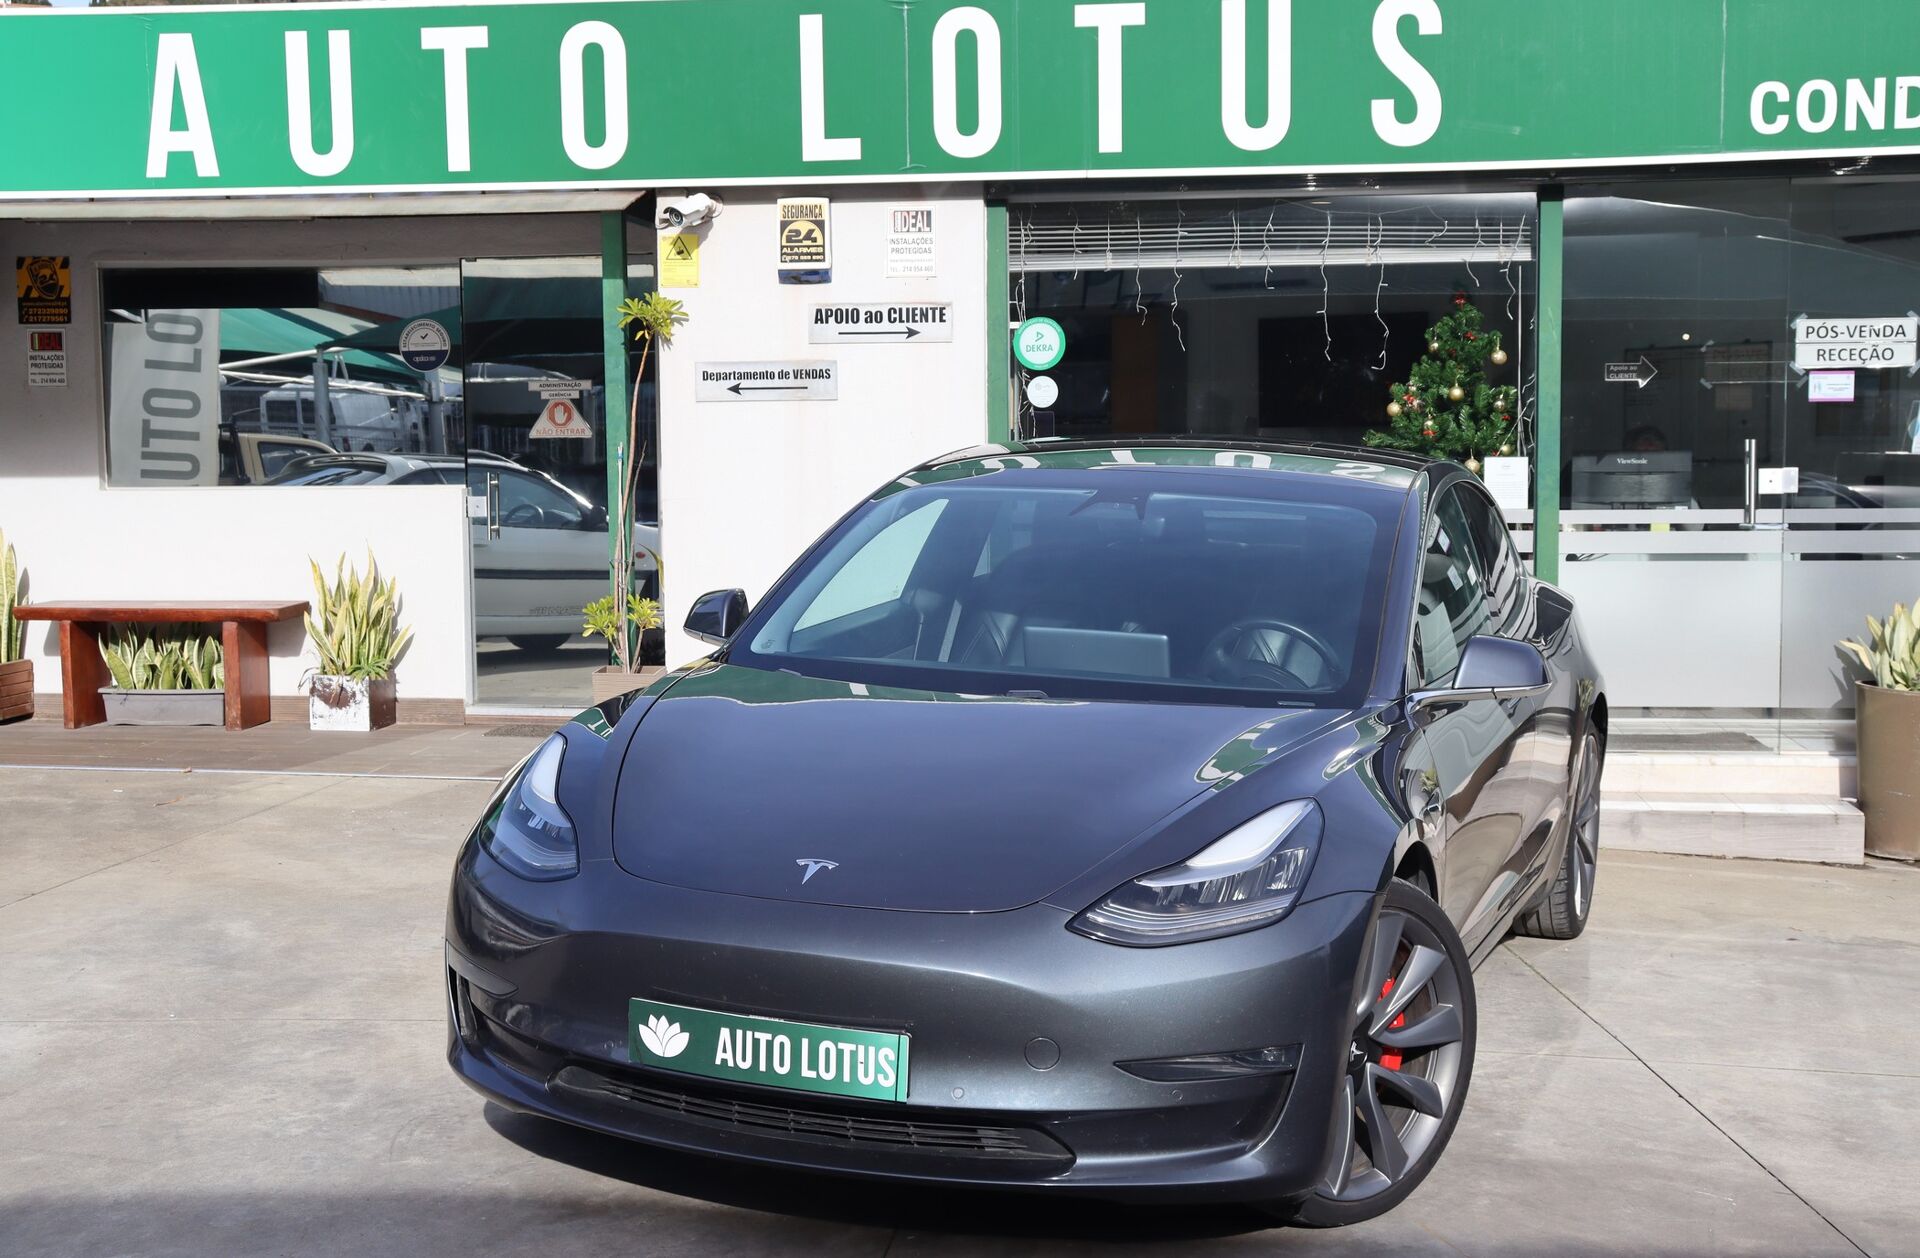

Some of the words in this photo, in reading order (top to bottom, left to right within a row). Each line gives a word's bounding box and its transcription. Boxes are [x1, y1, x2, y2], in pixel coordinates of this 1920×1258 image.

[145, 20, 630, 179] AUTO
[799, 0, 1443, 162] LOTUS
[1750, 76, 1920, 135] COND
[894, 210, 931, 232] IDEAL
[785, 228, 818, 244] 24
[889, 237, 934, 246] INSTALAÇÕES
[890, 246, 932, 255] PROTEGIDAS
[814, 307, 860, 324] APOIO
[864, 310, 883, 324] ao
[887, 306, 947, 323] CLIENTE
[1805, 322, 1906, 339] PÓS-VENDA
[1025, 344, 1054, 353] DEKRA
[1816, 344, 1895, 365] RECEÇÃO
[29, 354, 65, 362] INSTALAÇÕES
[702, 370, 776, 382] Departamento
[777, 369, 791, 380] de
[792, 368, 831, 380] VENDAS
[140, 388, 202, 486] UTO
[535, 427, 554, 435] NÃO
[1616, 457, 1649, 465] ViewSonic
[714, 1027, 791, 1075] AUTO
[801, 1037, 896, 1088] LOTUS
